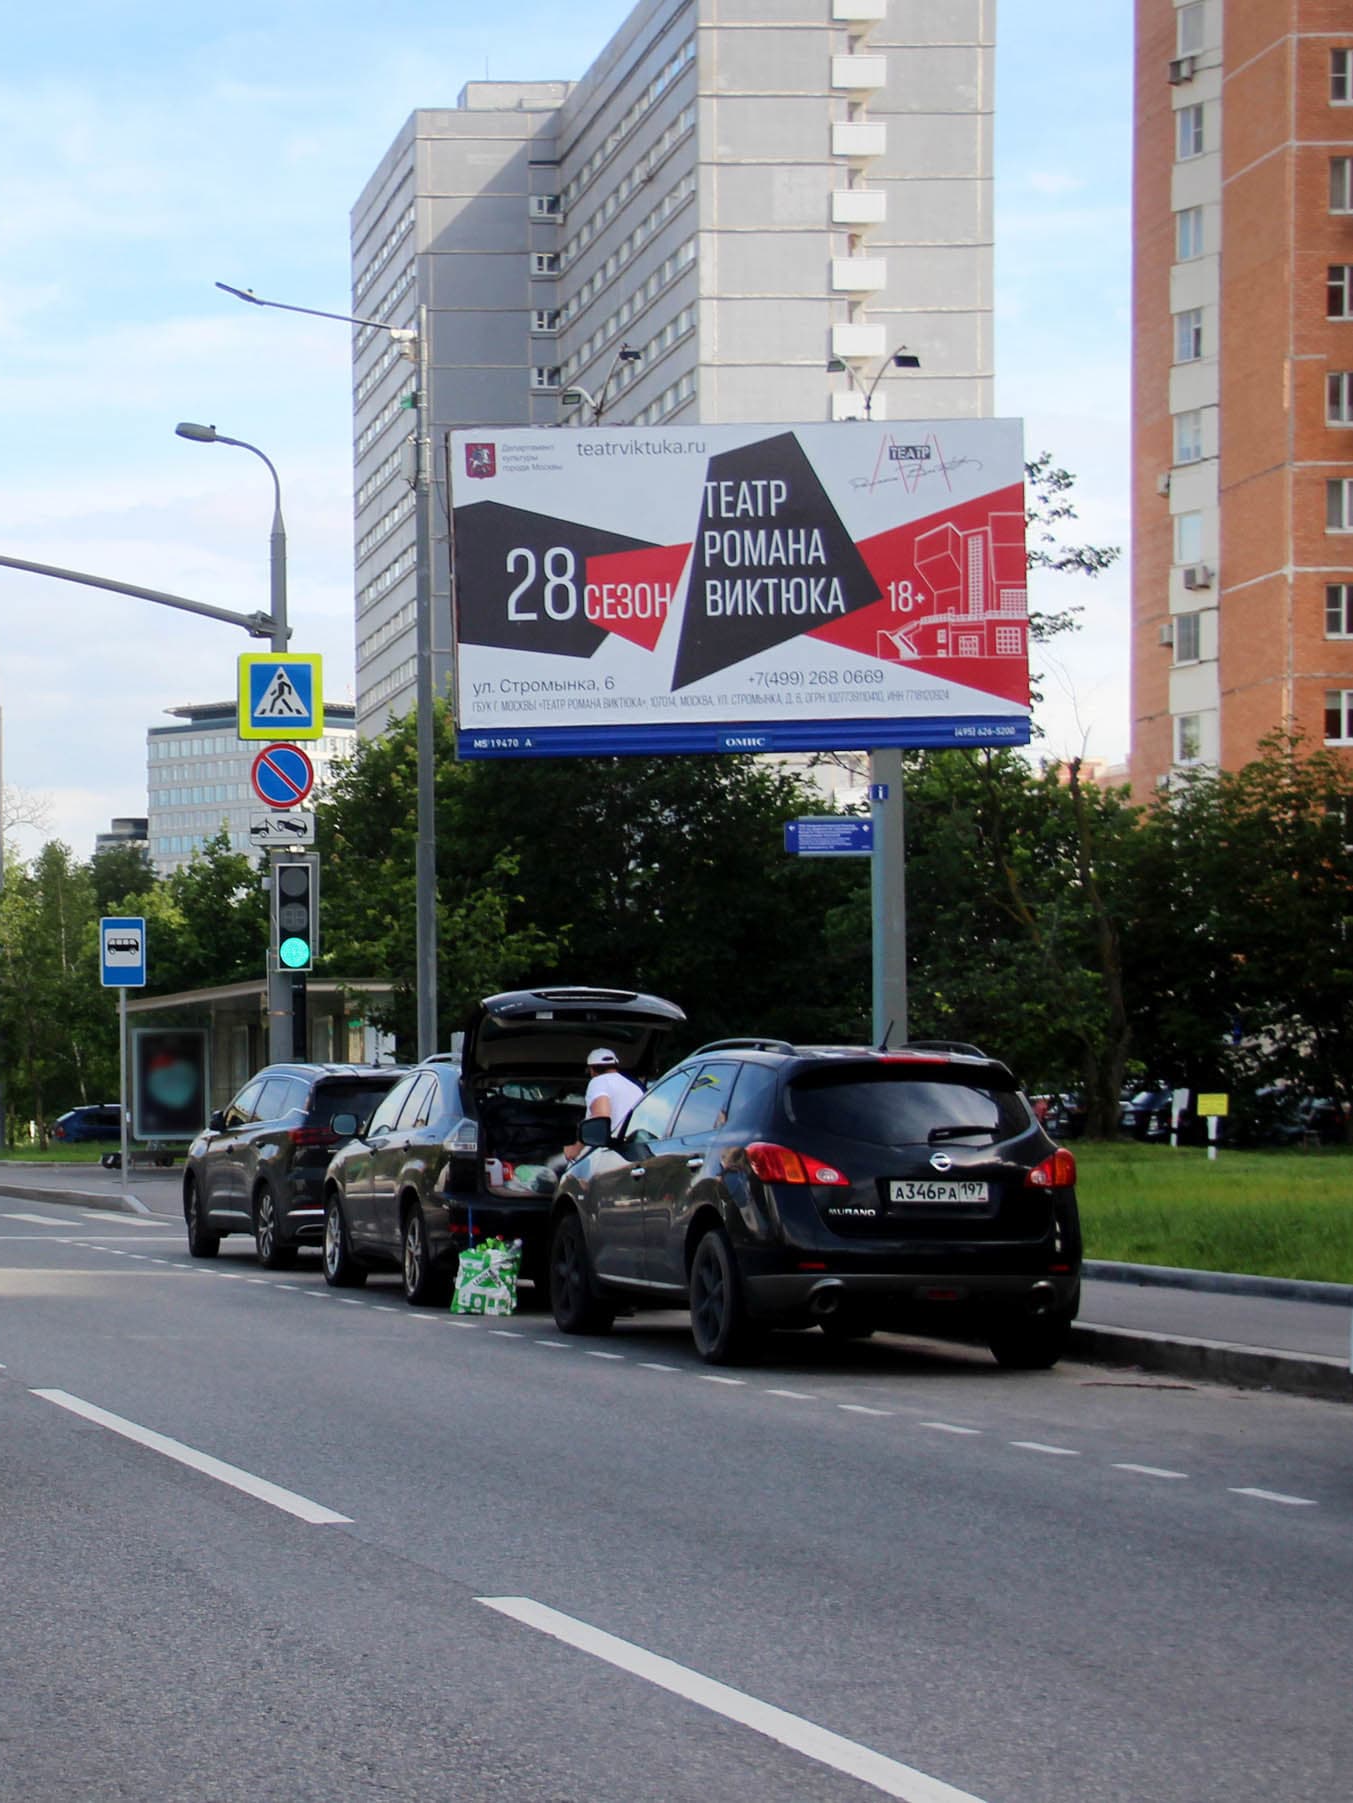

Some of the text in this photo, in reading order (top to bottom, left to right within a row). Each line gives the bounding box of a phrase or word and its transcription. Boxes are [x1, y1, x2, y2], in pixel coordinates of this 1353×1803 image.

[576, 439, 707, 456] teatrviktuka.ru
[891, 447, 930, 459] ТЕАТР
[704, 480, 787, 518] ТЕАТР
[704, 529, 826, 567] РОМАНА
[506, 546, 672, 621] 28 СЕЗОН
[705, 577, 845, 616] ВИКТЮКА
[887, 581, 925, 612] 18+
[472, 676, 616, 697] ул. Стромынка, 6
[749, 669, 884, 688] +7(499) 268 0669
[960, 1182, 983, 1196] 197
[828, 1207, 876, 1217] MURANO
